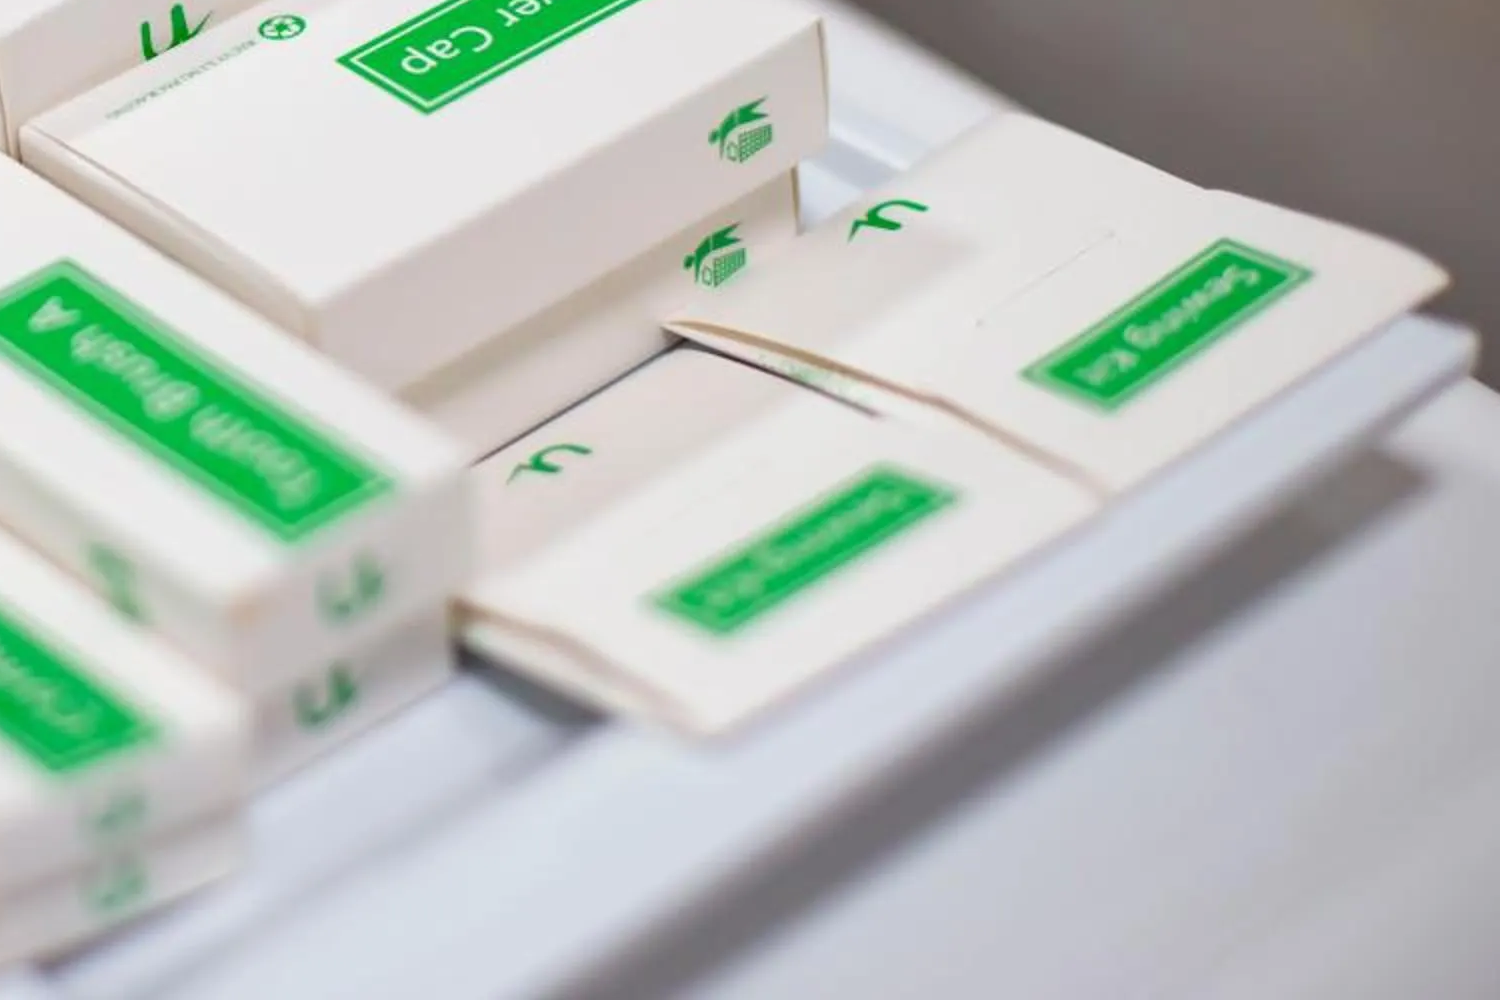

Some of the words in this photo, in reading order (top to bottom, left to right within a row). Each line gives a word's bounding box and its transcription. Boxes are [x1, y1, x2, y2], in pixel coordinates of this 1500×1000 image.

[400, 24, 493, 75] Cap
[27, 296, 81, 333] A
[1122, 263, 1261, 350] Sewing
[70, 323, 200, 423] Brush
